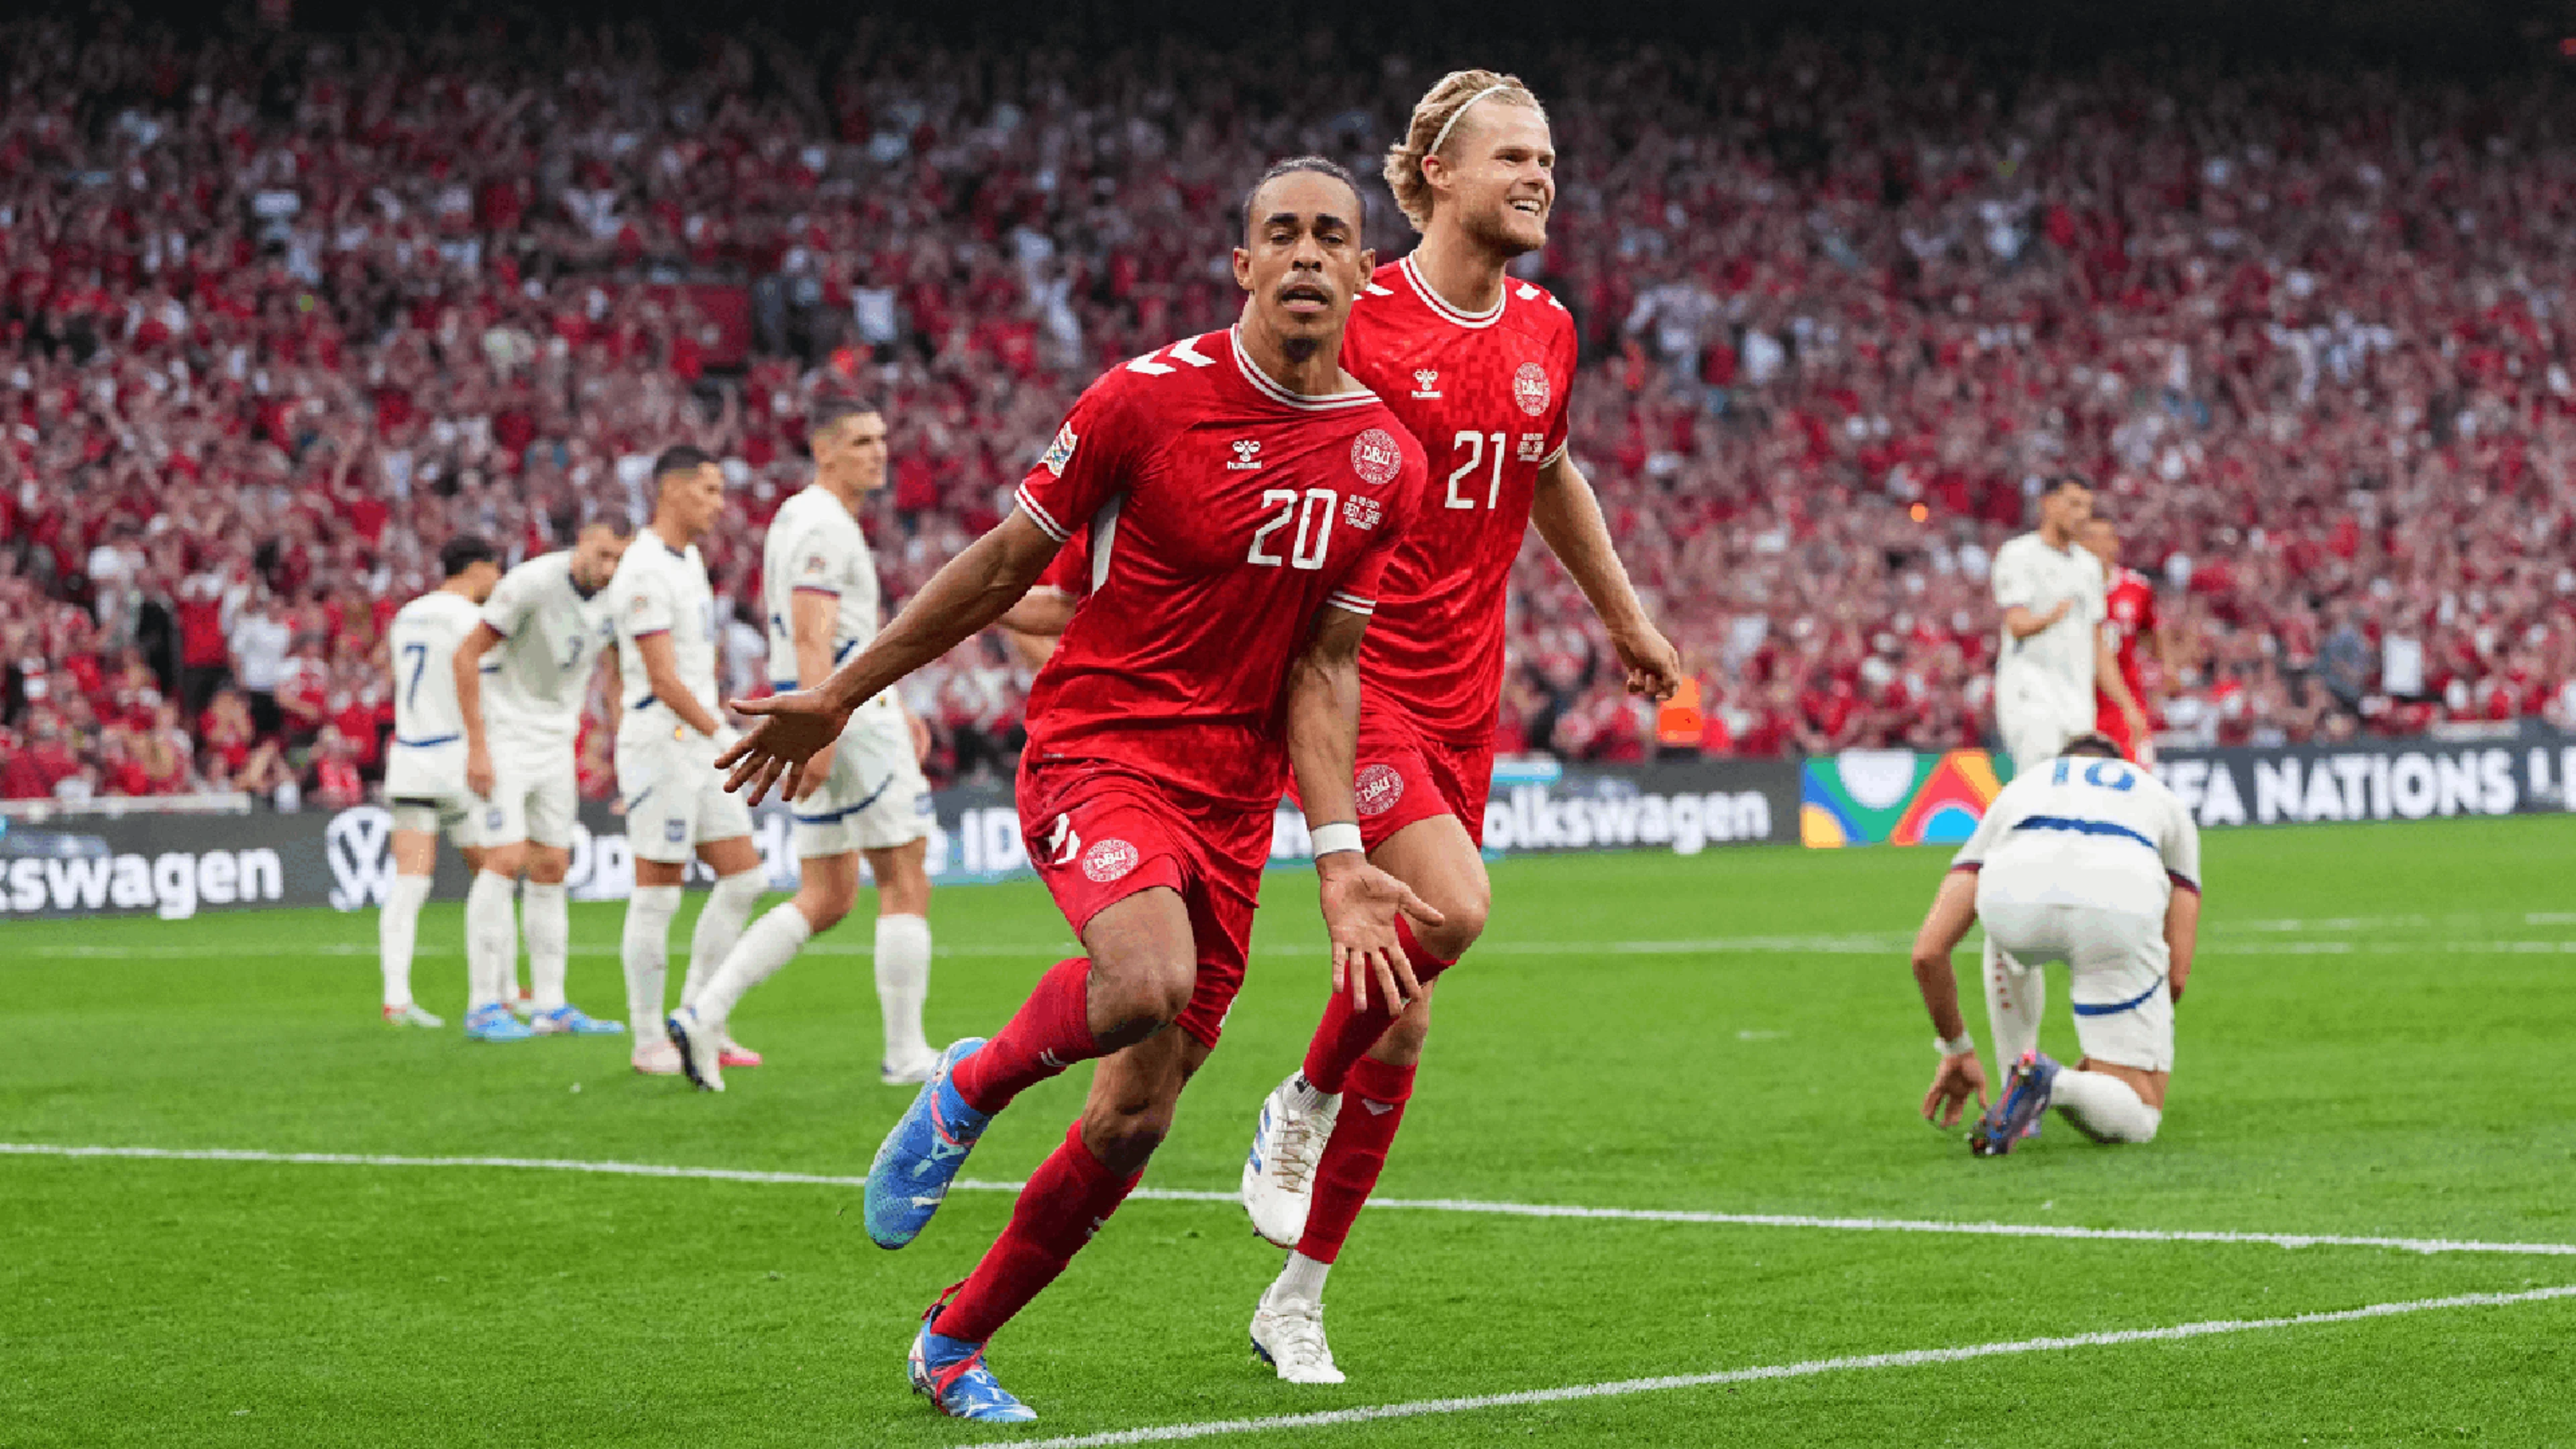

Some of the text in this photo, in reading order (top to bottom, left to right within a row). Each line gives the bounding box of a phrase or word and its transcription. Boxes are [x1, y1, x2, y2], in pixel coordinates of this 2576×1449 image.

[1362, 445, 1391, 465] DBU
[1445, 430, 1506, 509] 21
[1247, 488, 1337, 570] 20
[403, 641, 429, 710] 7
[1481, 784, 1772, 855] olkswagen
[2151, 757, 2247, 826] FA
[2253, 747, 2518, 824] NATIONS
[1094, 849, 1126, 869] DBU
